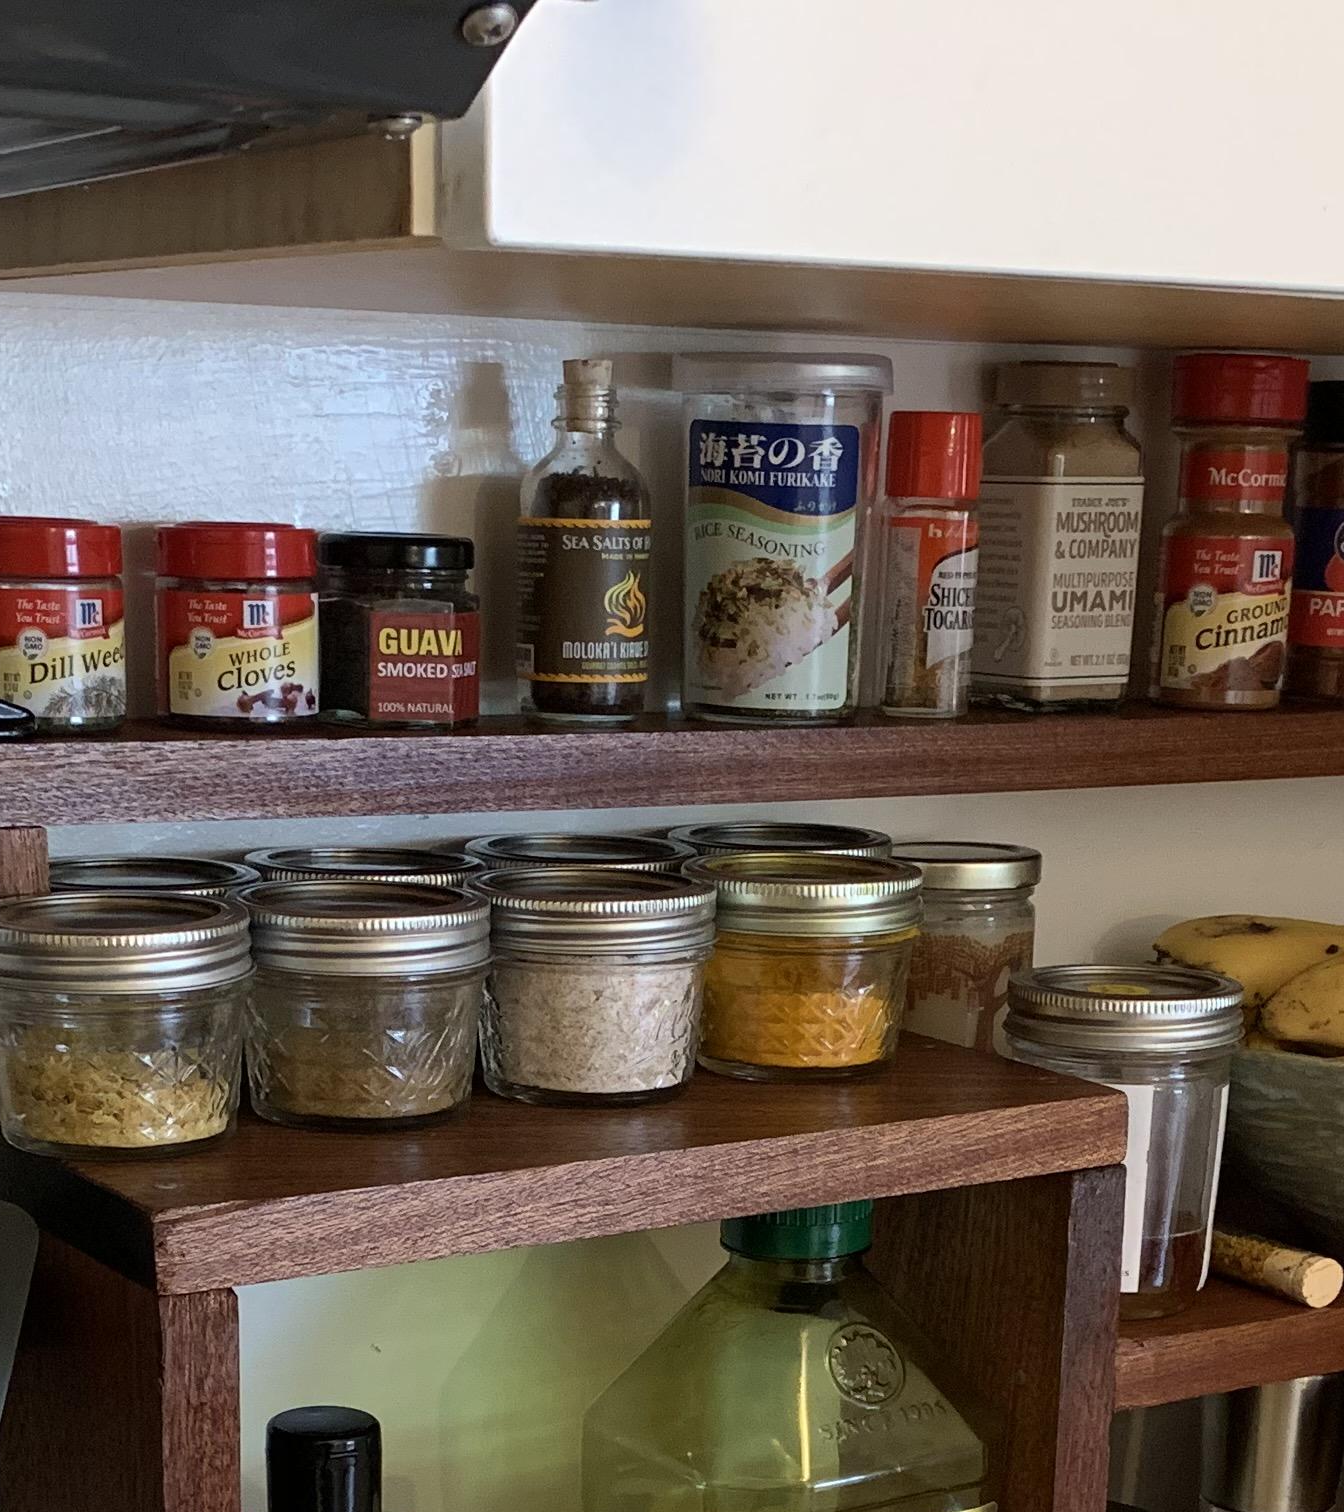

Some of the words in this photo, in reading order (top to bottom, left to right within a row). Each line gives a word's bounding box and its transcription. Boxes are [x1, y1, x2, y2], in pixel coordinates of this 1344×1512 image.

[699, 432, 844, 471] 海苔の香
[701, 470, 726, 484] NORI
[730, 470, 765, 486] KOMI
[770, 472, 837, 488] FURIKAKE
[1057, 511, 1139, 538] MUSHROOM
[562, 534, 590, 550] SEA
[593, 535, 629, 550] SALTS
[694, 522, 723, 541] RICE
[728, 524, 825, 558] SEASONING
[1055, 540, 1065, 559] &
[1069, 539, 1137, 559] COMPANY
[1053, 571, 1135, 589] MULTIPURPOSE
[17, 598, 33, 610] The
[36, 599, 62, 610] Taste
[188, 599, 203, 610] The
[205, 599, 228, 610] Taste
[1051, 589, 1134, 613] UMAMI
[16, 612, 33, 623] You
[36, 612, 62, 625] Trust
[187, 612, 202, 623] You
[1051, 614, 1103, 630] SEASONING
[24, 635, 43, 643] NON
[24, 643, 43, 651] GMO
[194, 635, 211, 643] NON
[378, 627, 463, 656] GUAVA
[229, 642, 291, 667] WHOLE
[562, 641, 617, 659] MOLOKA'I
[30, 656, 75, 684] Dill
[217, 660, 297, 691] Cloves
[377, 662, 448, 678] SMOKED
[377, 702, 405, 712] 100%
[407, 703, 454, 713] NATURAL
